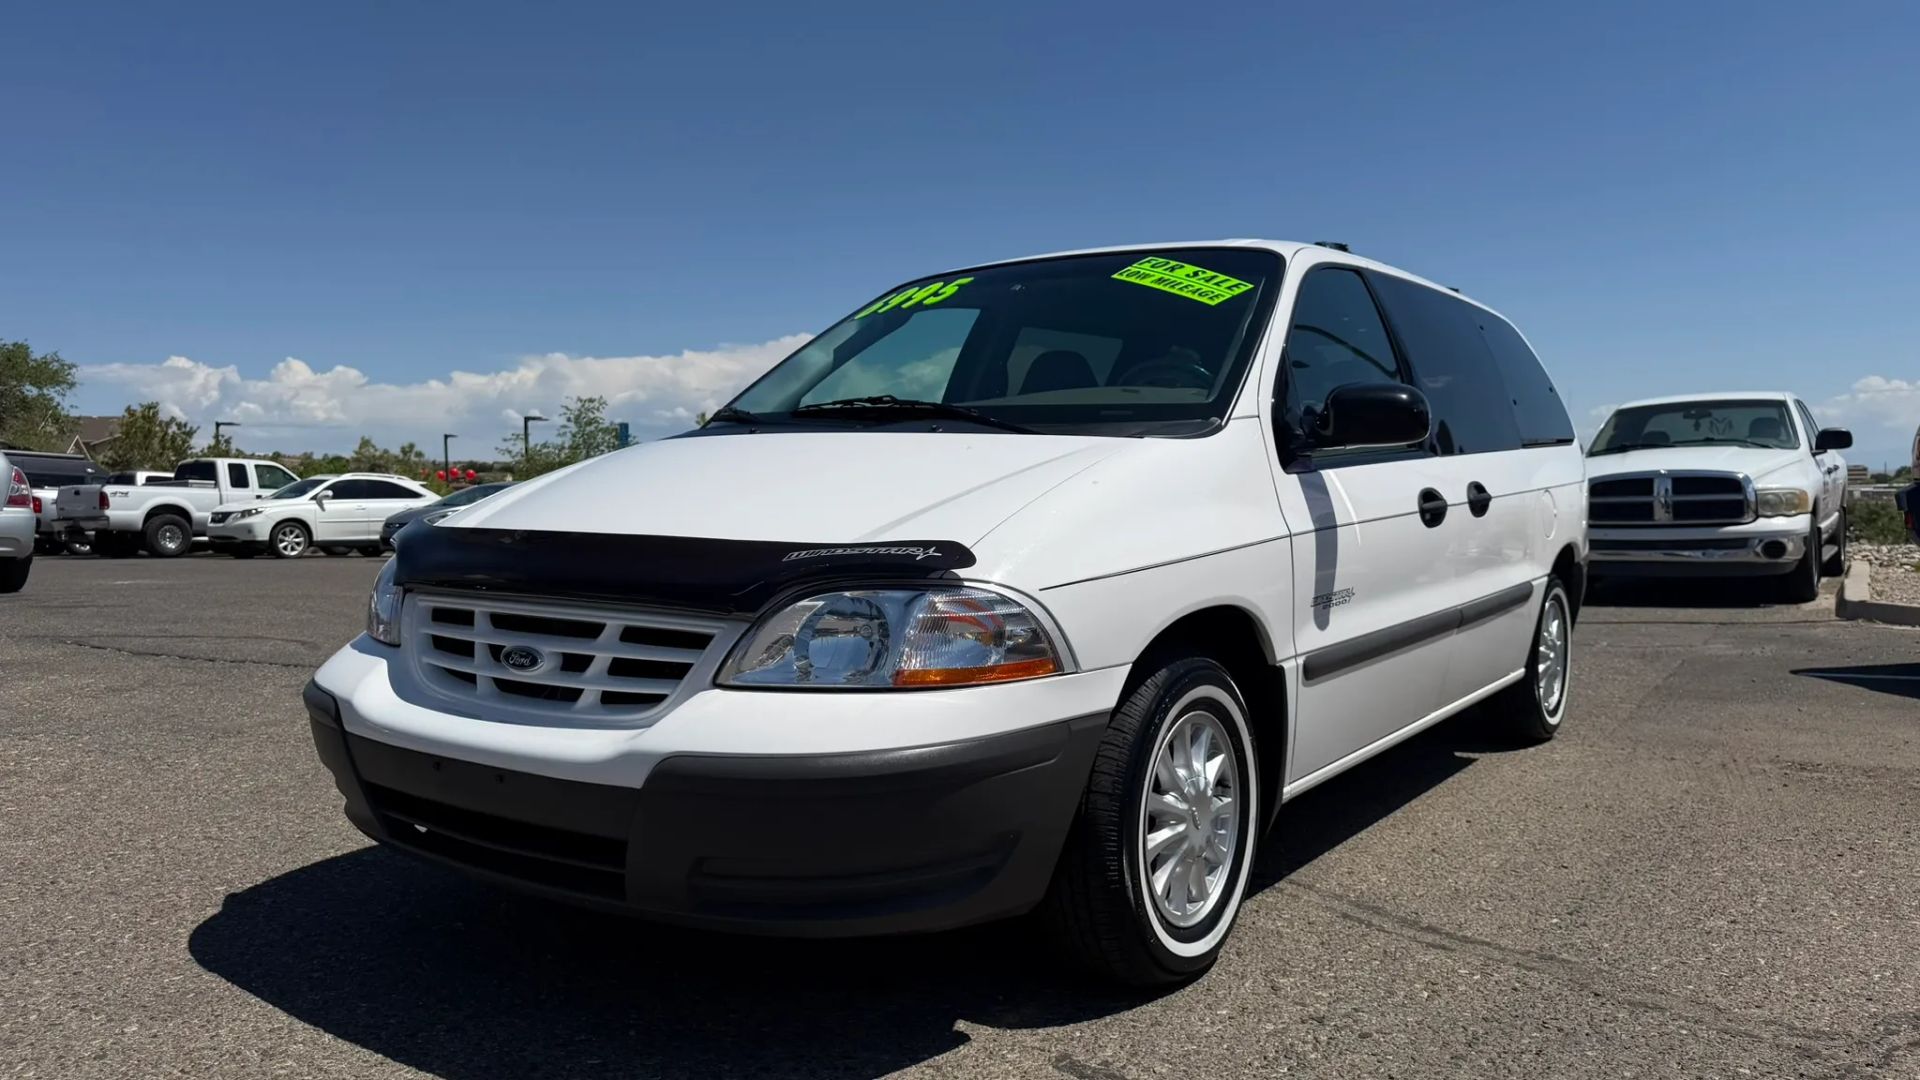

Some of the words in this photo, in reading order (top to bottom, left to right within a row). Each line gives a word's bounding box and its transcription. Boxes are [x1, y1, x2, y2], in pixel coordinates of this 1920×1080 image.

[1118, 268, 1155, 280] LOW
[1150, 276, 1225, 300] MILEAGE
[1136, 259, 1185, 273] FOR
[1185, 269, 1248, 291] SALE
